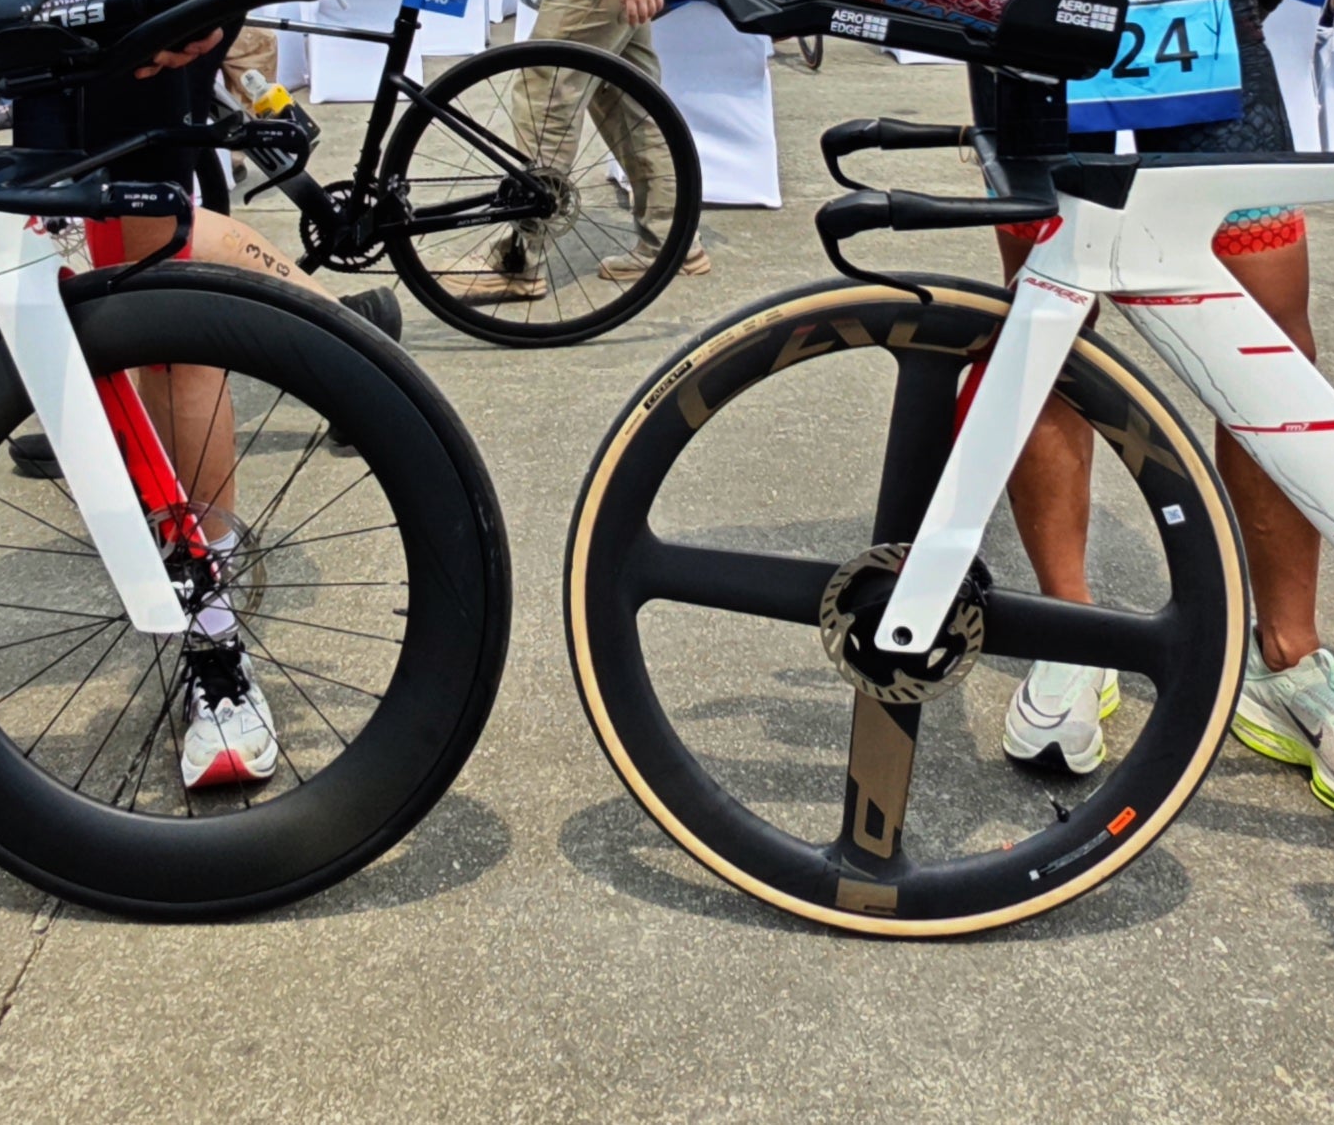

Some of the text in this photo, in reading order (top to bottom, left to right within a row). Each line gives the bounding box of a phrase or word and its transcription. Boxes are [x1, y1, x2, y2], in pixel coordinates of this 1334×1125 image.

[831, 9, 864, 24] AERO
[1056, 11, 1091, 26] EDGE
[830, 21, 862, 36] EDGE
[245, 243, 291, 277] 348
[1023, 277, 1089, 307] AVENGER
[677, 318, 1187, 479] CADX
